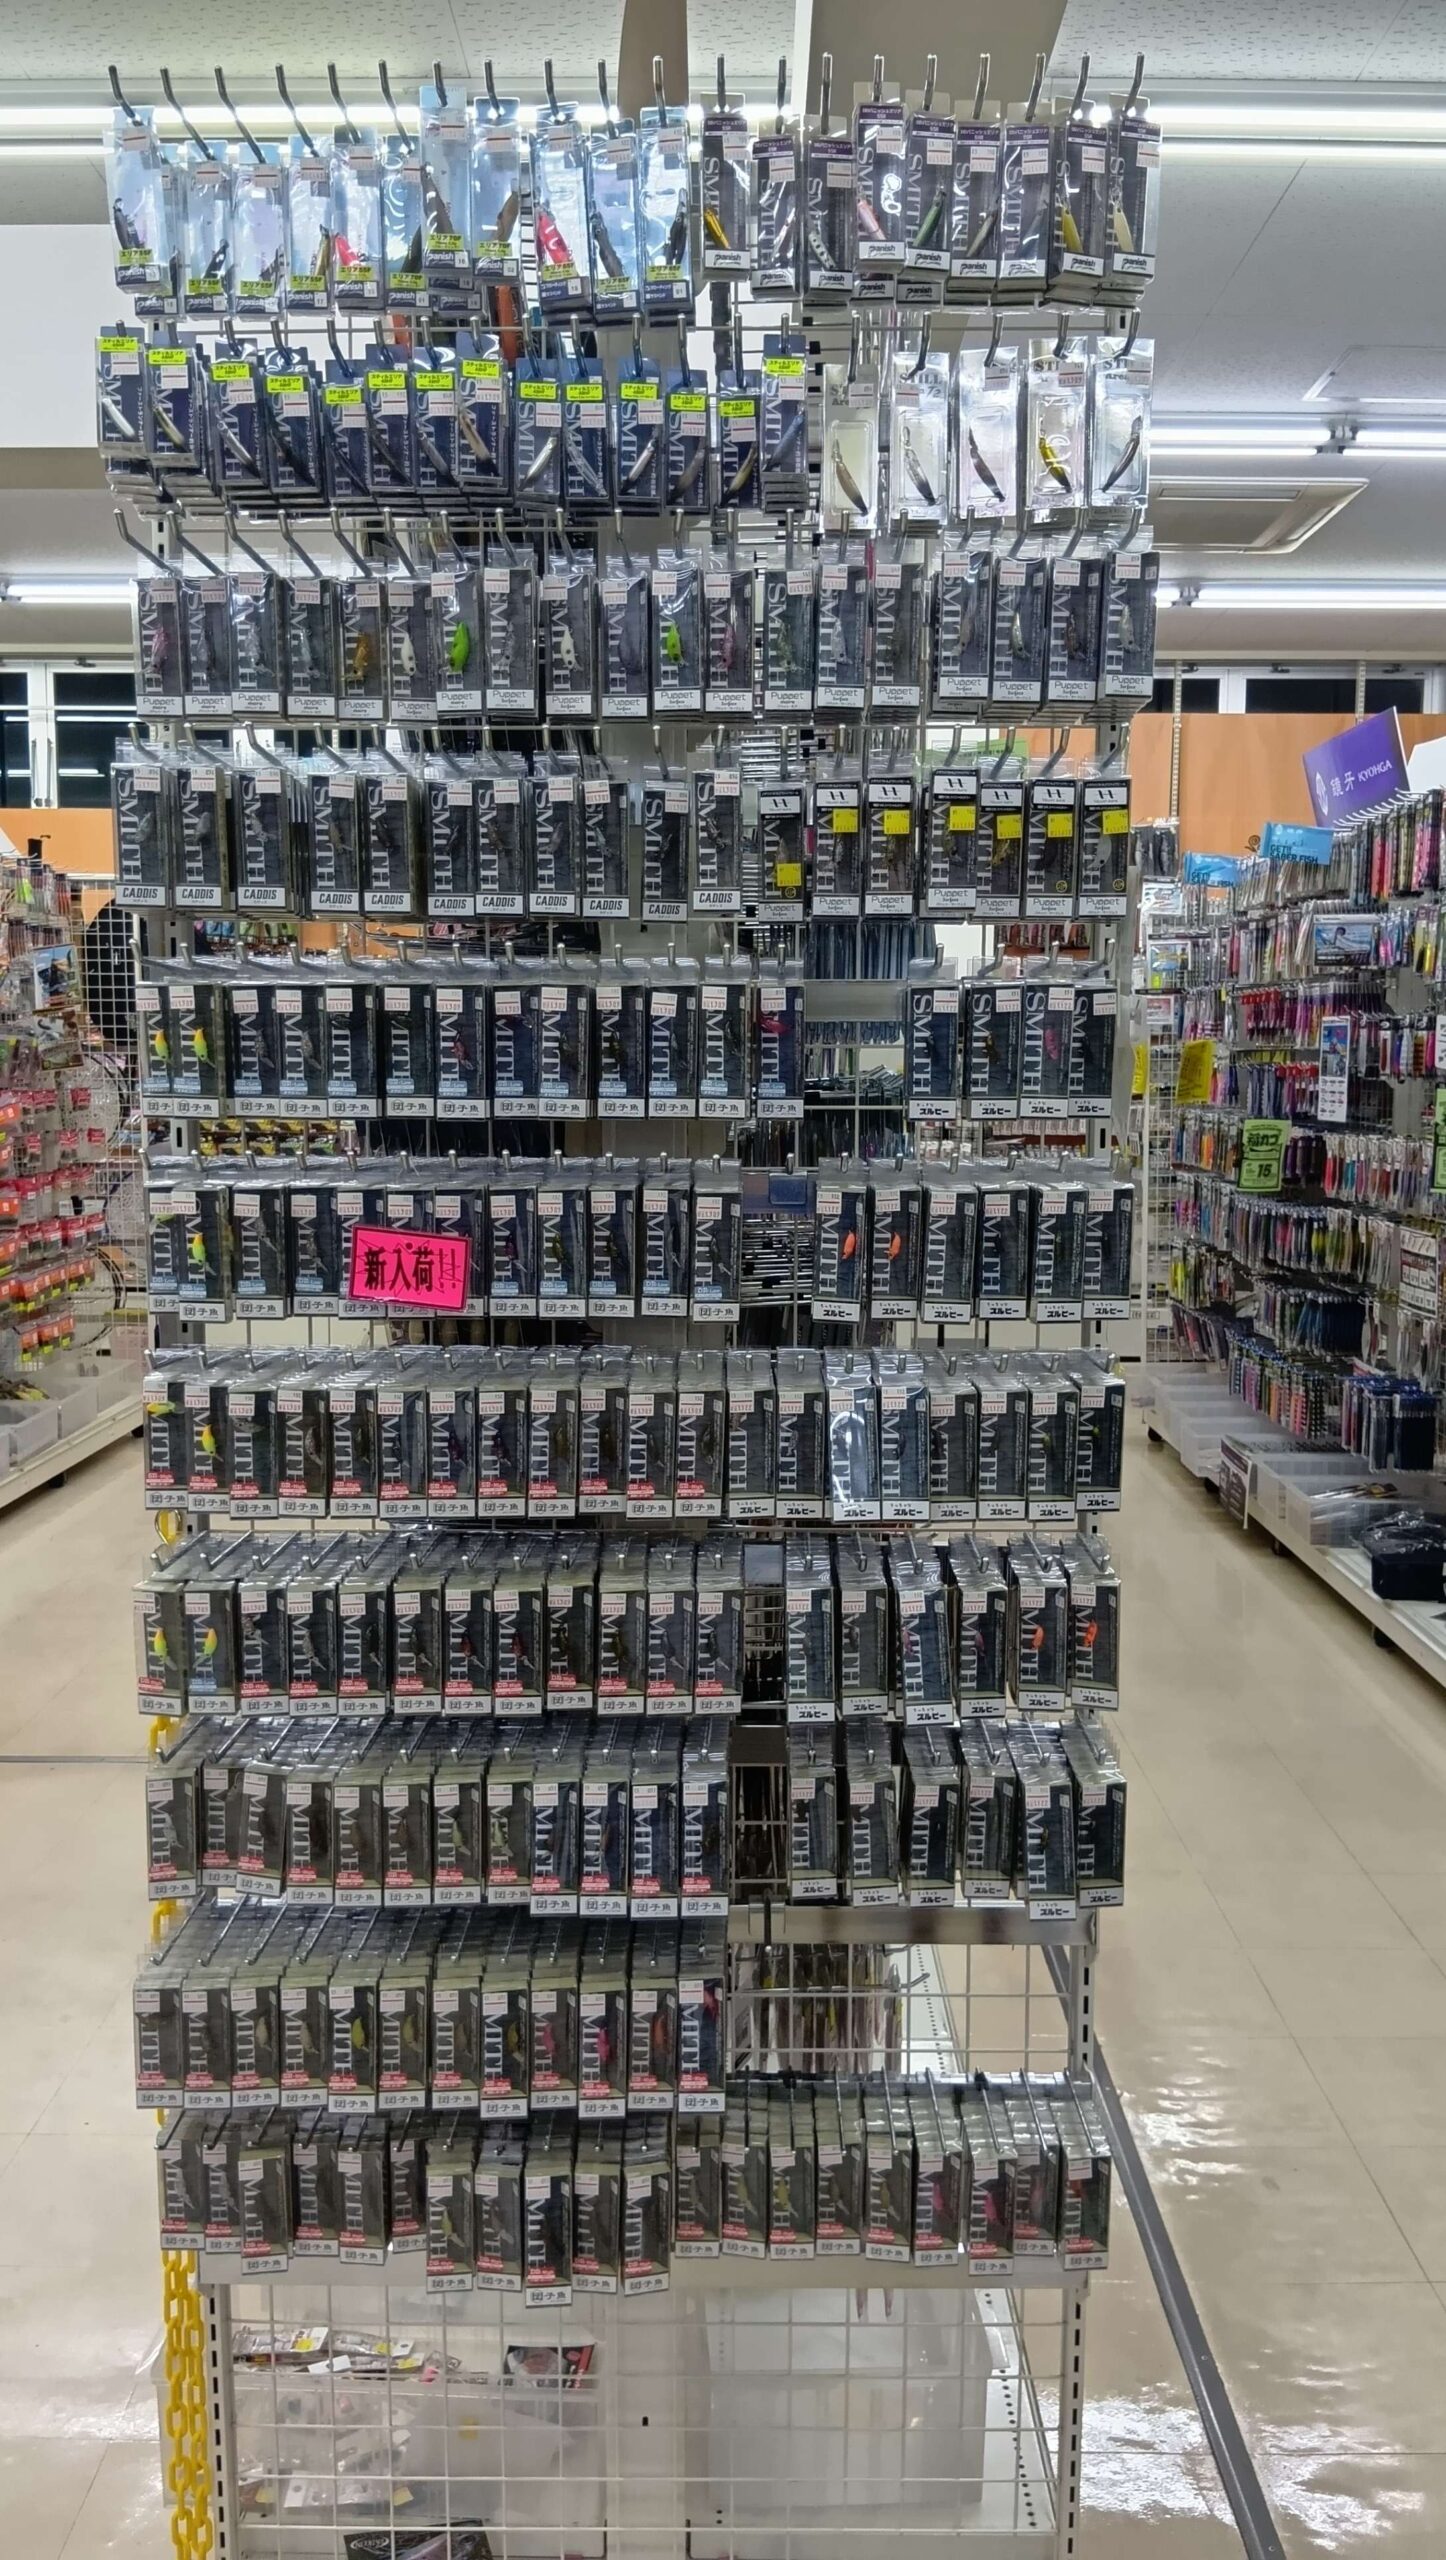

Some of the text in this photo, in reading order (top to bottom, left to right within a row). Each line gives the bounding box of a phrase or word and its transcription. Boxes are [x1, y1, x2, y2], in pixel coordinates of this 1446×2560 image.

[906, 154, 923, 243] SMITH
[768, 583, 787, 688] SMITH
[948, 678, 982, 687] Puppet
[1112, 676, 1145, 684] Puppet
[1000, 682, 1033, 690] Puppet
[1055, 682, 1088, 690] Puppet
[493, 691, 526, 699] Puppet
[661, 692, 694, 700] Puppet
[771, 692, 803, 700] Puppet
[824, 688, 857, 697] Puppet
[879, 687, 913, 696] Puppet
[192, 697, 224, 705] Puppet
[238, 694, 272, 702] Puppet
[441, 693, 472, 701] Puppet
[552, 696, 584, 704] Puppet
[713, 694, 746, 702] Puppet
[143, 698, 175, 706] Puppet
[294, 698, 327, 706] Puppet
[344, 701, 376, 709] Puppet
[398, 702, 431, 710] Puppet
[608, 699, 640, 708] Puppet
[1357, 760, 1392, 783] KYOHGA
[118, 780, 142, 883] SMITH
[180, 780, 204, 884] SMITH
[313, 787, 335, 888] SMITH
[431, 790, 453, 892] SMITH
[535, 790, 556, 891] SMITH
[645, 800, 663, 898] SMITH
[123, 887, 158, 899] CADDIS
[182, 888, 214, 900] CADDIS
[244, 889, 277, 900] CADDIS
[934, 890, 968, 898] Puppet
[319, 893, 353, 904] CADDIS
[371, 894, 404, 905] CADDIS
[482, 897, 516, 907] CADDIS
[535, 896, 568, 906] CADDIS
[699, 893, 733, 904] CADDIS
[820, 898, 852, 907] Puppet
[872, 896, 904, 905] Puppet
[980, 899, 1014, 907] Puppet
[1033, 898, 1066, 906] Puppet
[1086, 898, 1120, 906] Puppet
[434, 899, 467, 909] CADDIS
[590, 900, 623, 910] CADDIS
[764, 904, 796, 912] Puppet
[649, 904, 680, 915] CADDIS
[913, 995, 932, 1094] SMITH
[971, 994, 992, 1094] SMITH
[1024, 992, 1046, 1093] SMITH
[1069, 996, 1088, 1092] SMITH
[364, 1246, 456, 1292] 新入荷!!
